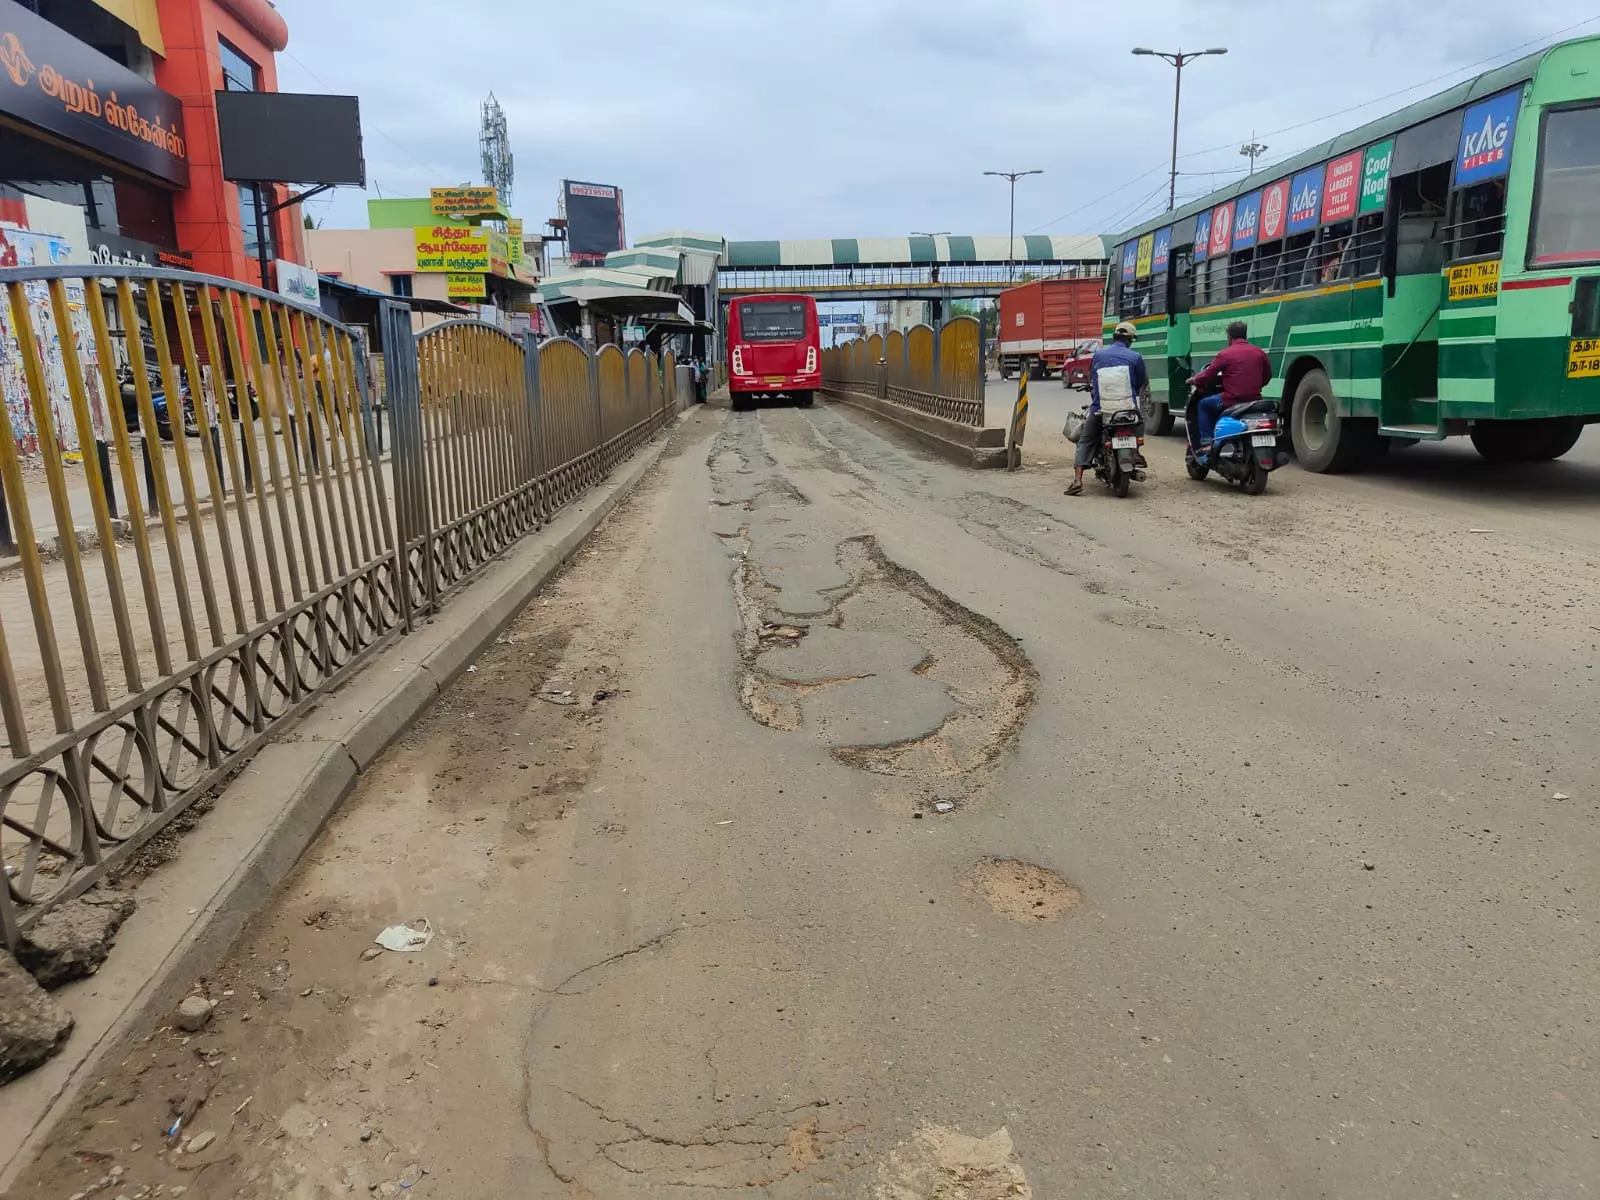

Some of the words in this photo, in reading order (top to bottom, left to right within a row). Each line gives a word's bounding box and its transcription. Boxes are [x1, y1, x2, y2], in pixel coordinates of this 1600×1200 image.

[39, 64, 101, 117] அறம்
[104, 90, 185, 158] ஸ்கேன்ஸ்
[1463, 113, 1509, 158] KAG
[1366, 151, 1391, 176] Cool
[1463, 148, 1503, 169] TILES
[1328, 176, 1354, 193] LARGEST
[1363, 171, 1389, 197] Roof
[1292, 181, 1318, 213] KAG
[1331, 191, 1348, 205] TILES
[1236, 204, 1256, 233] KAG
[1292, 208, 1316, 222] TILES
[432, 226, 471, 240] சித்தா
[1236, 227, 1254, 240] TILES
[416, 241, 488, 255] ஆயுர்வேதா
